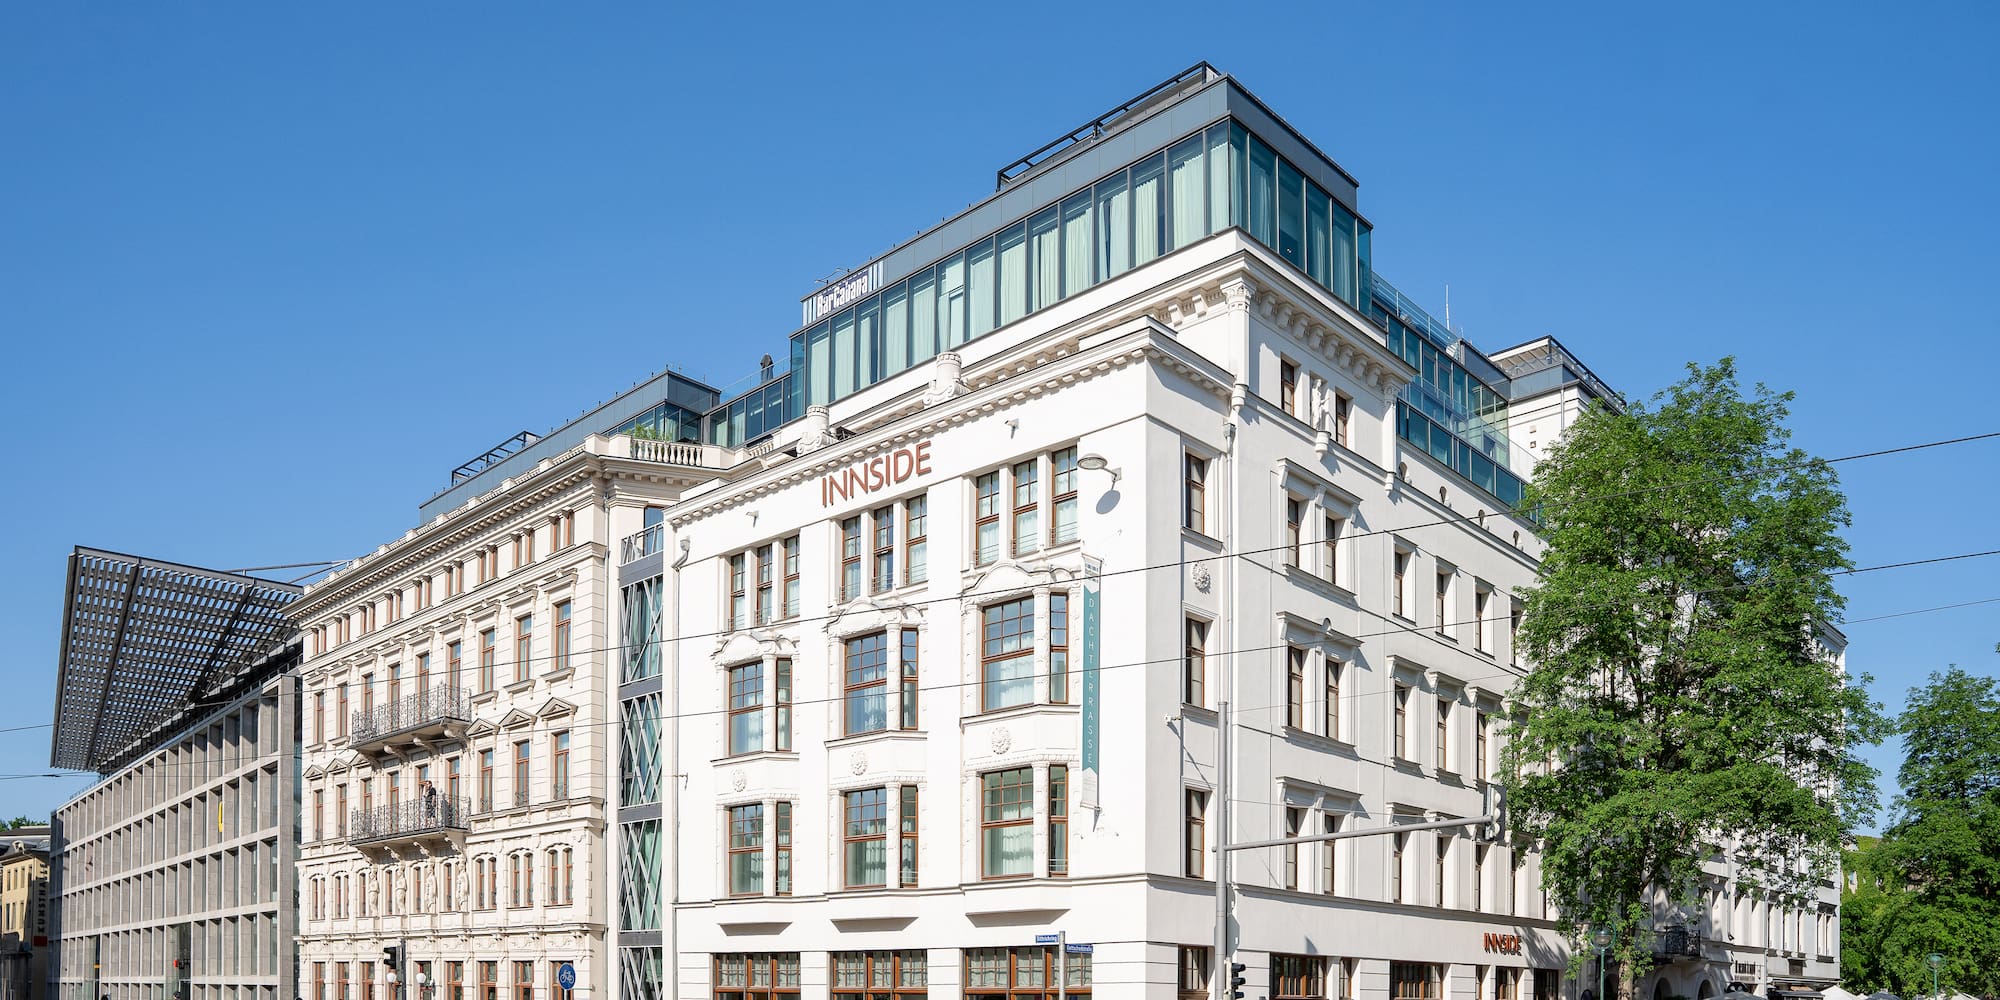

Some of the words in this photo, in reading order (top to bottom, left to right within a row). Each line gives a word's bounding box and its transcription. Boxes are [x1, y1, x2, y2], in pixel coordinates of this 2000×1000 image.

[816, 274, 868, 318] BarCabana
[822, 440, 932, 508] INNSIDE
[1087, 598, 1095, 763] DACHTERRASSE
[37, 863, 48, 934] KUNSTHALLE
[1484, 932, 1522, 955] INNSIDE
